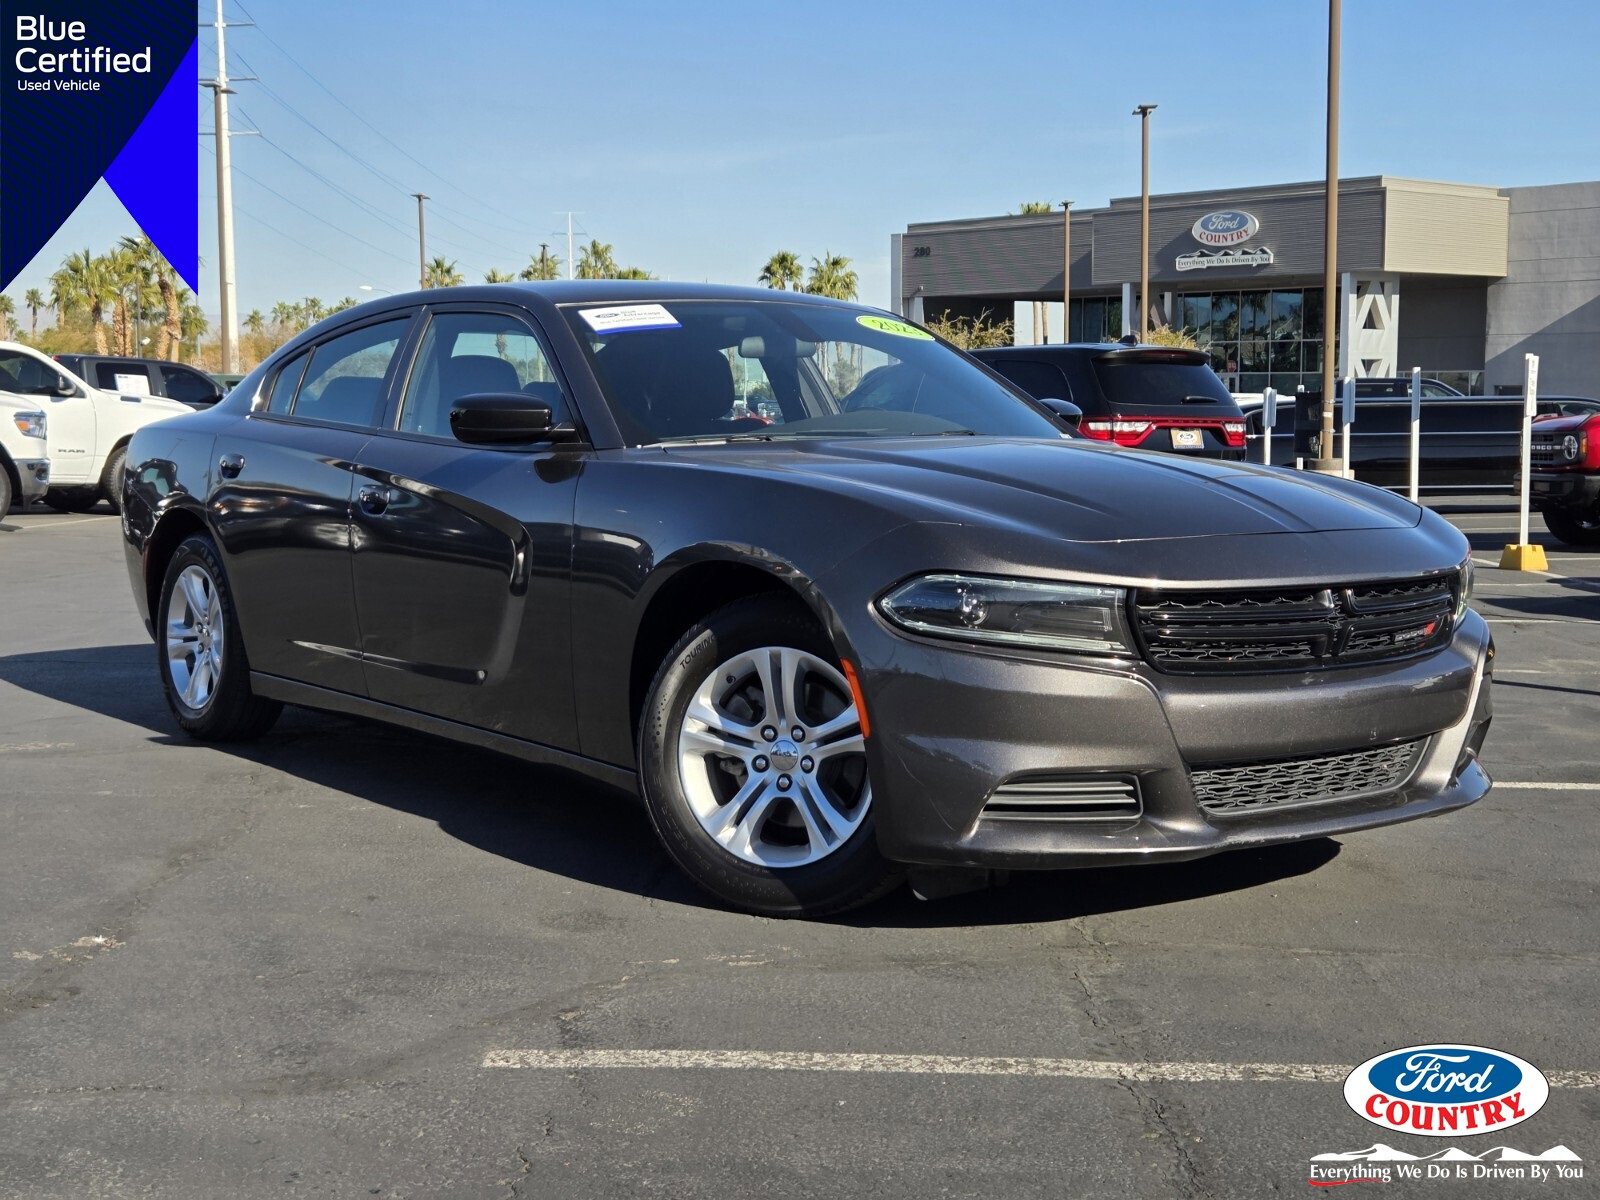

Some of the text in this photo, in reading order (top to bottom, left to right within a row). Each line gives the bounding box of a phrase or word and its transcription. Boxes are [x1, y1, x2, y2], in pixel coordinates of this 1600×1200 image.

[1208, 213, 1241, 231] Ford
[1199, 227, 1250, 243] COUNTRY
[1177, 257, 1206, 267] Everything
[1231, 256, 1250, 264] Driven
[1250, 256, 1258, 265] By
